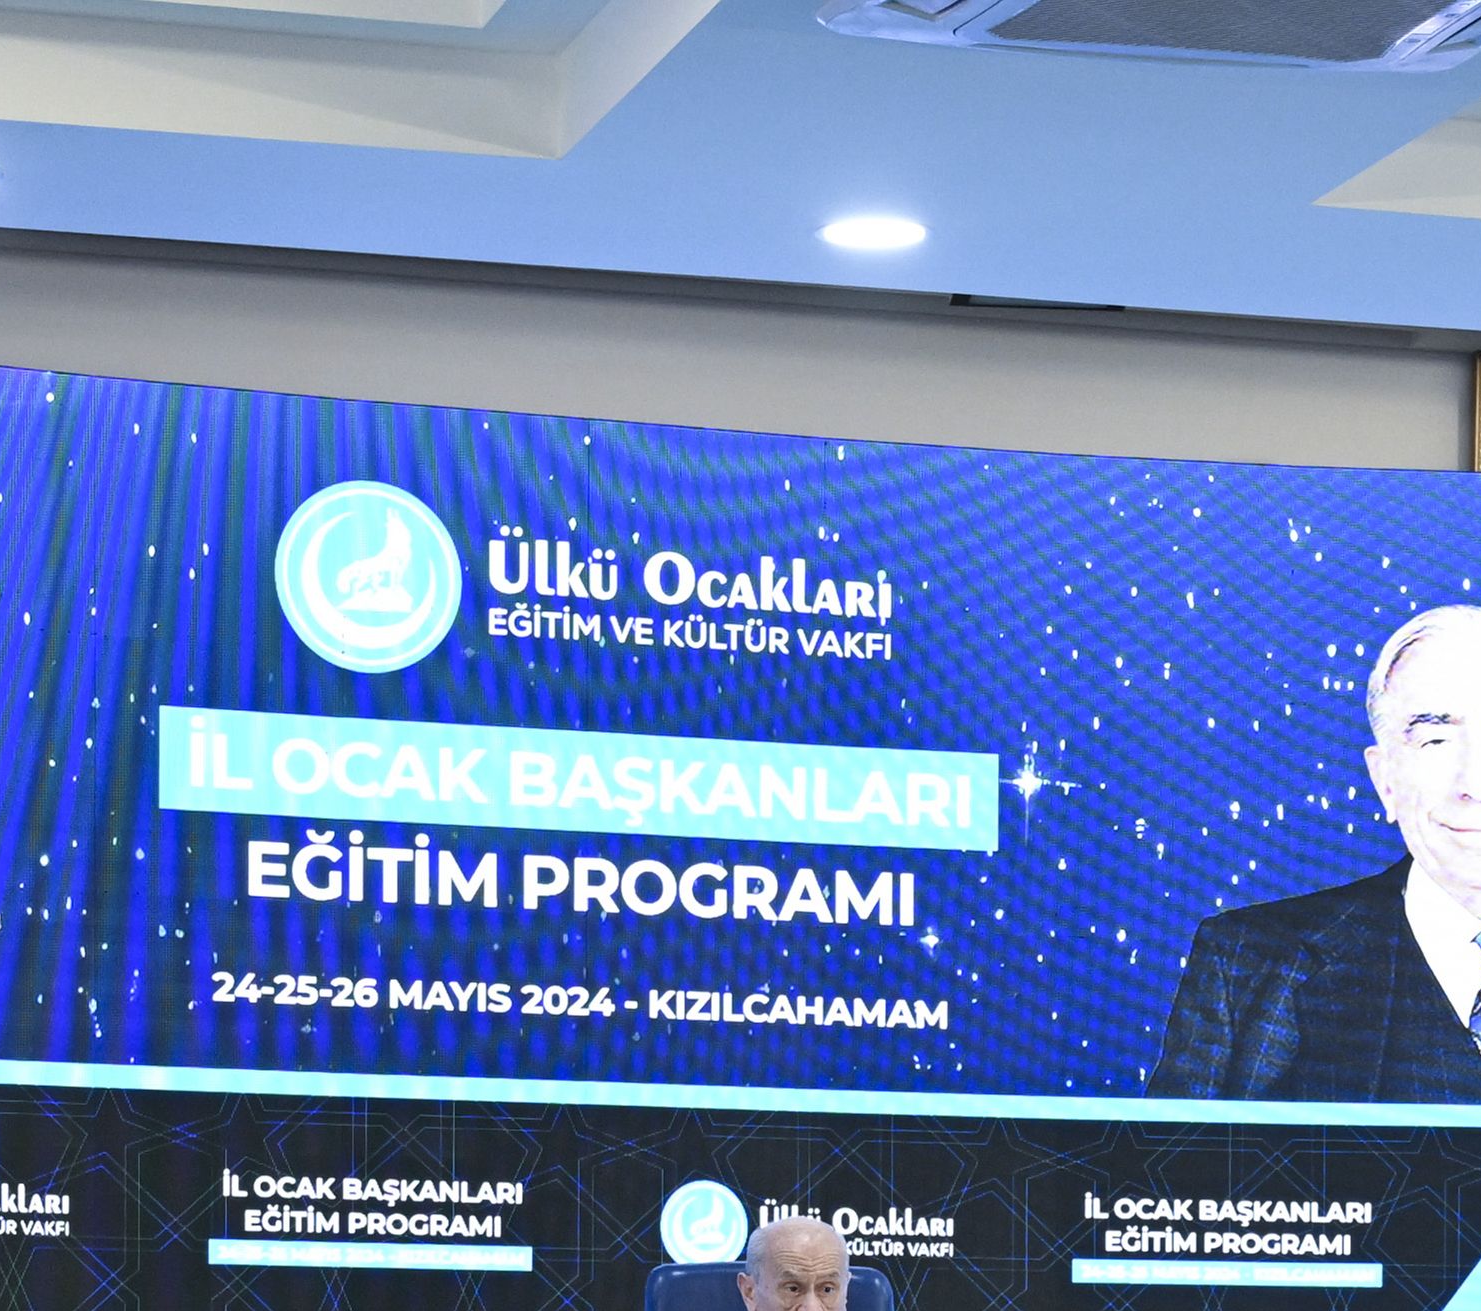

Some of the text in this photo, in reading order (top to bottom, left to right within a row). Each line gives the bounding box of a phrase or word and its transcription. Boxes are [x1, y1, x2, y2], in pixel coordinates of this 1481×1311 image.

[489, 525, 618, 601] Ülkü
[488, 602, 892, 660] EĞİTİM VE KÜLTÜR VAKFI
[188, 716, 972, 830] İL OCAK BAŞKANLARI
[248, 829, 914, 926] EĞİTİM PROGRAMI
[211, 971, 379, 1008] 24-25-26
[389, 979, 512, 1013] MAYIS
[520, 984, 616, 1017] 2024
[649, 989, 948, 1030] KIZILCAHAMAM
[222, 1168, 523, 1207] İL OCAK BAŞKANLARI
[20, 1220, 70, 1237] VAKFI
[244, 1204, 502, 1238] EĞİTİM PROGRAMI
[1084, 1191, 1372, 1227] İL OCAK BAŞKANLARI
[907, 1242, 954, 1258] VAKFI
[1105, 1225, 1351, 1256] EĞİTİM PROGRAMI
